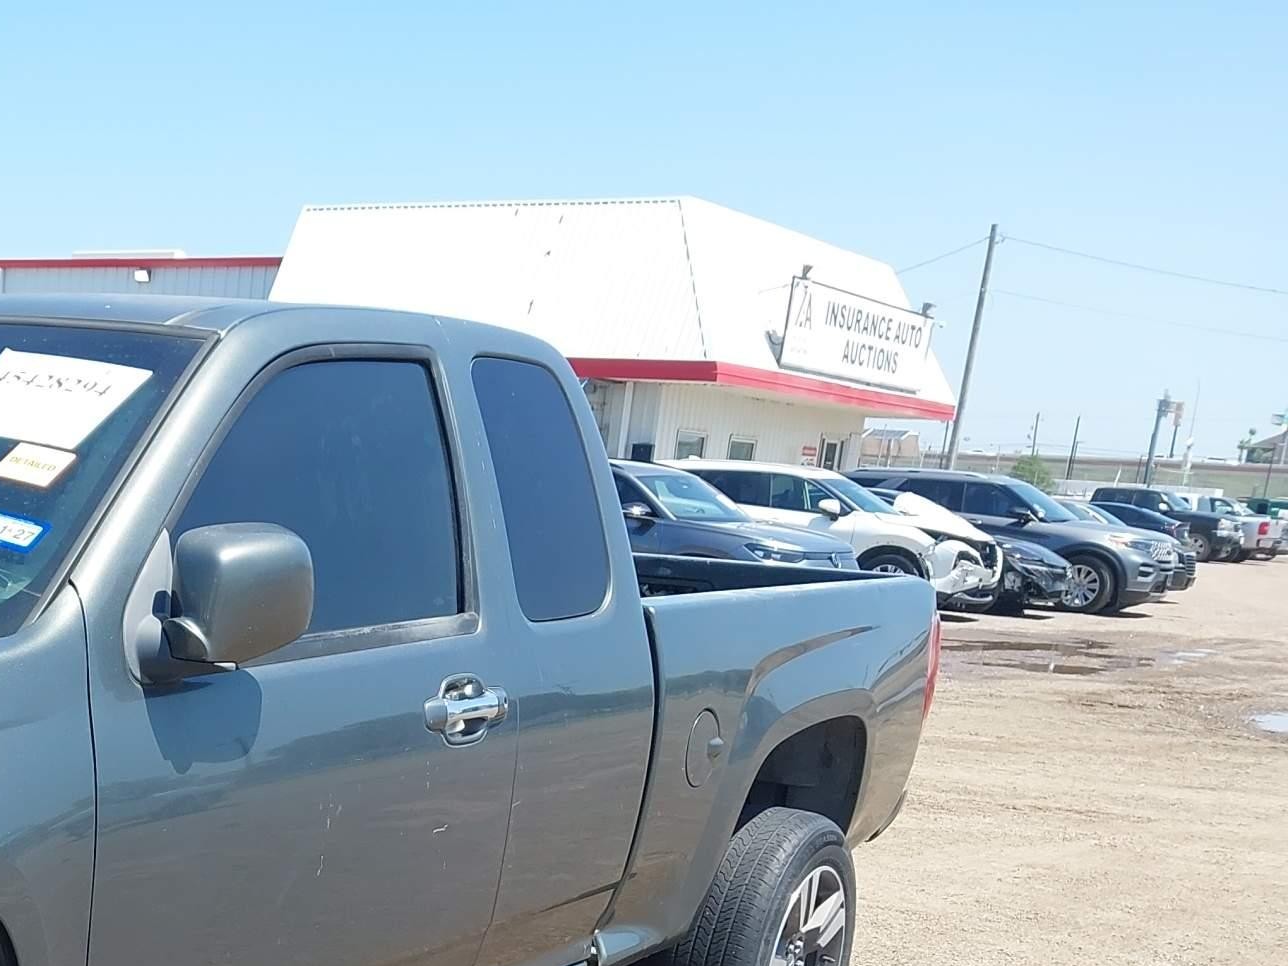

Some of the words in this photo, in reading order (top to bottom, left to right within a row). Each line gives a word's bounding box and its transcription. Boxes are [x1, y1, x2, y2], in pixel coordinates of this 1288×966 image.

[825, 300, 893, 341] INSURANCE
[893, 321, 923, 348] AUTO
[841, 339, 899, 374] AUCTIONS
